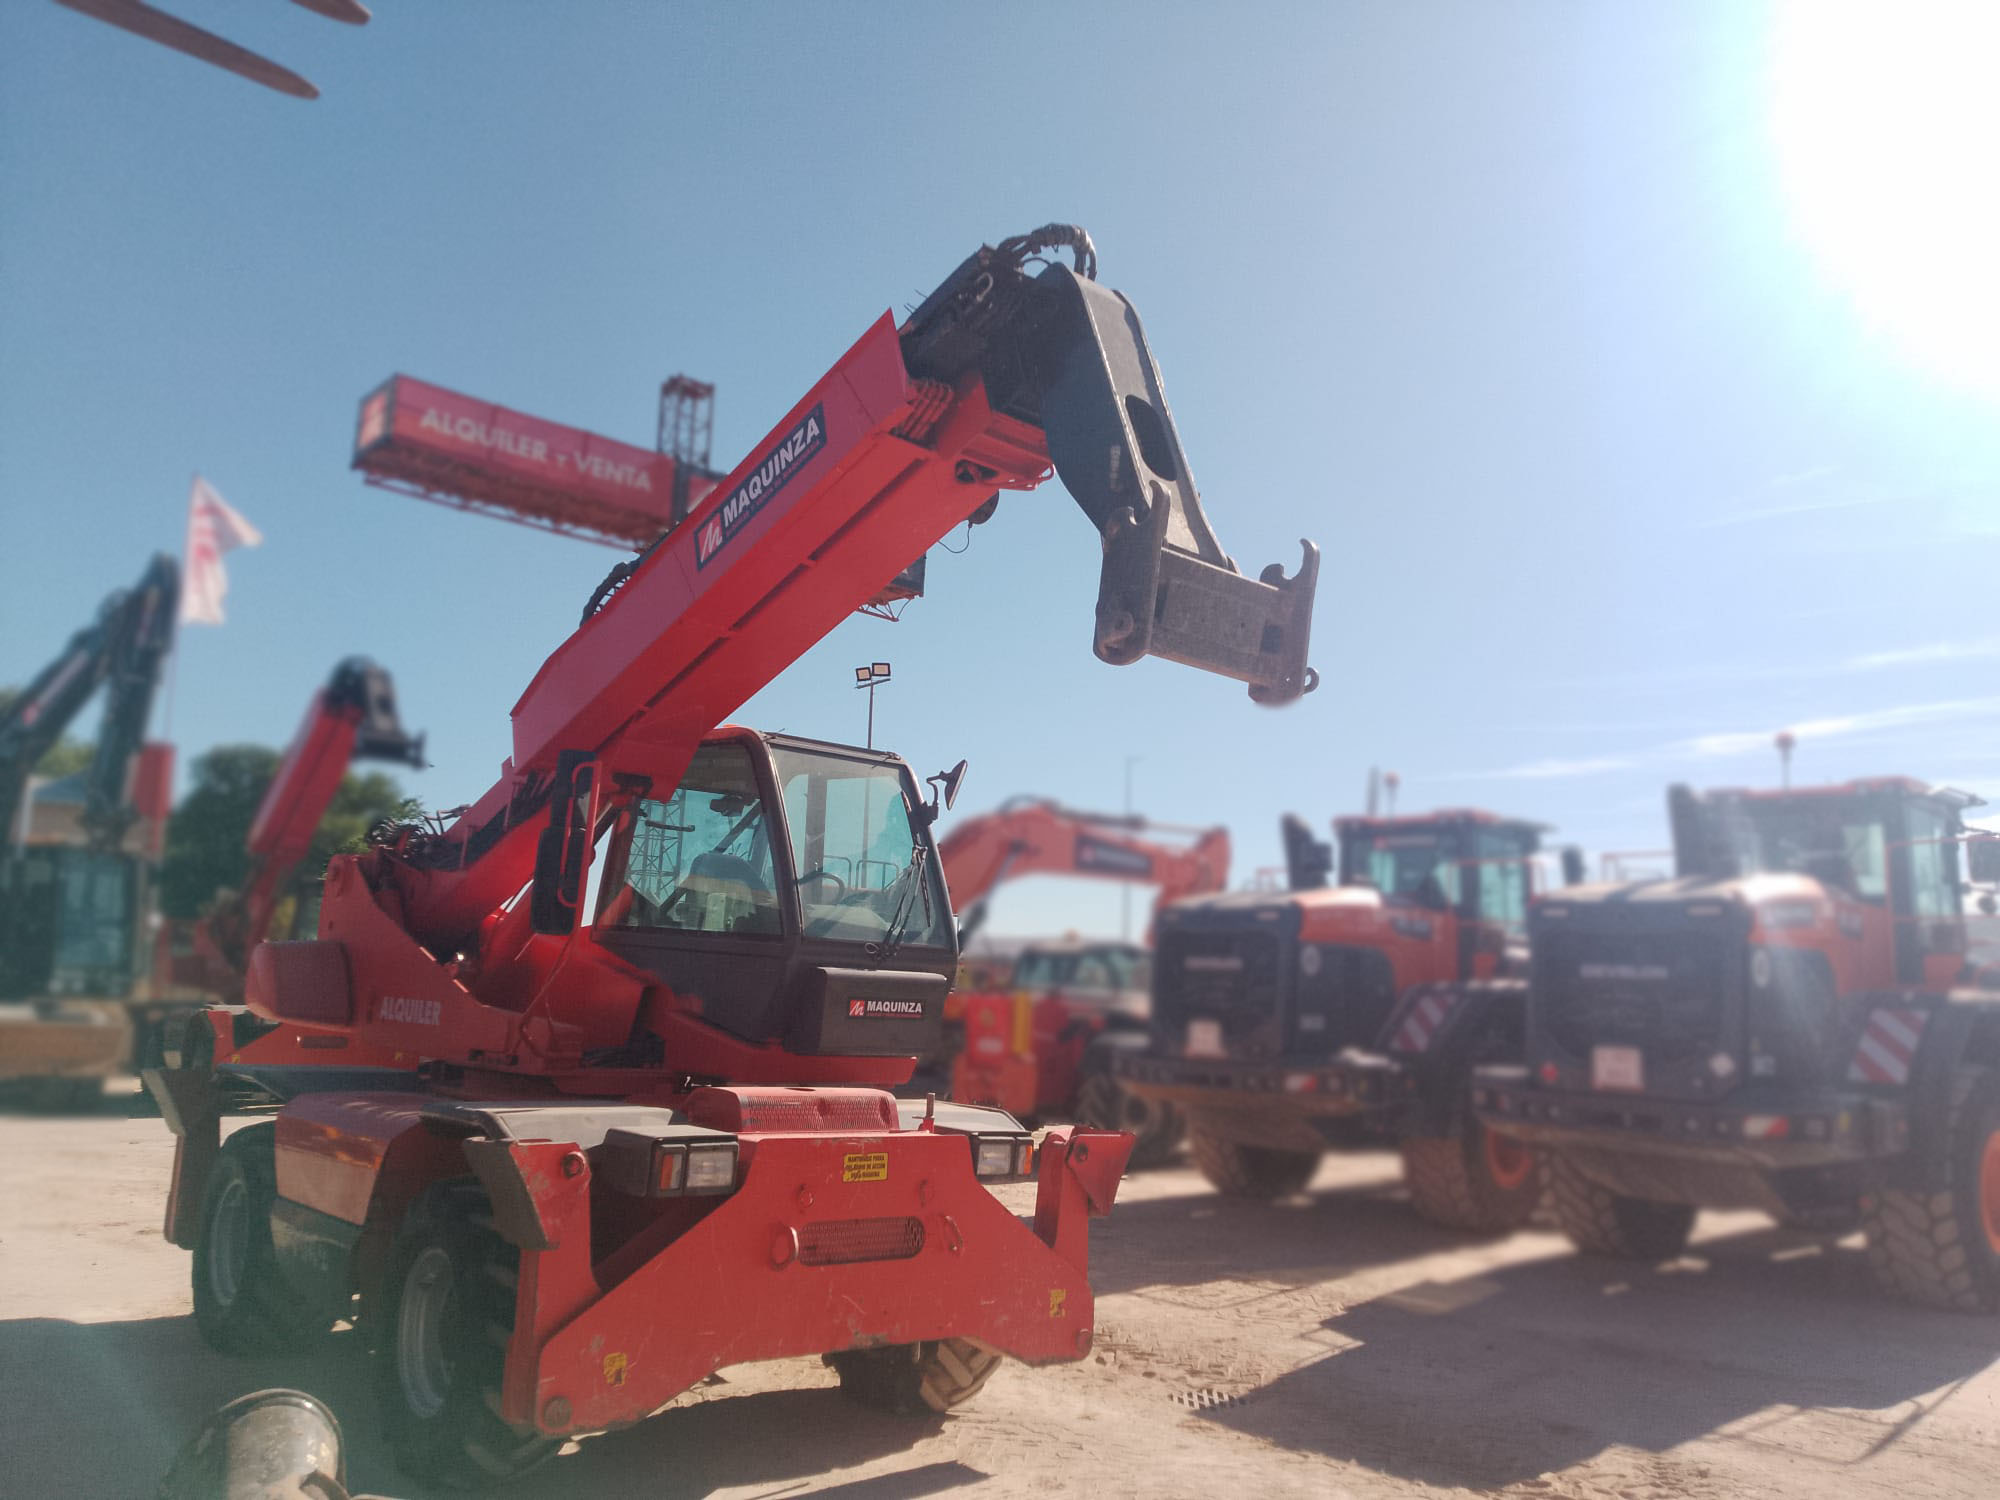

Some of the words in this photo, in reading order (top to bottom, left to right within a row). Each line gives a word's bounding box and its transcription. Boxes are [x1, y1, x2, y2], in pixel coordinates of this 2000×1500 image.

[419, 408, 549, 462] ALQUILER
[573, 451, 651, 492] VENTA
[722, 416, 821, 528] MAQUINZA
[380, 995, 442, 1026] ALQUILER
[866, 1000, 923, 1014] MAQUINZA
